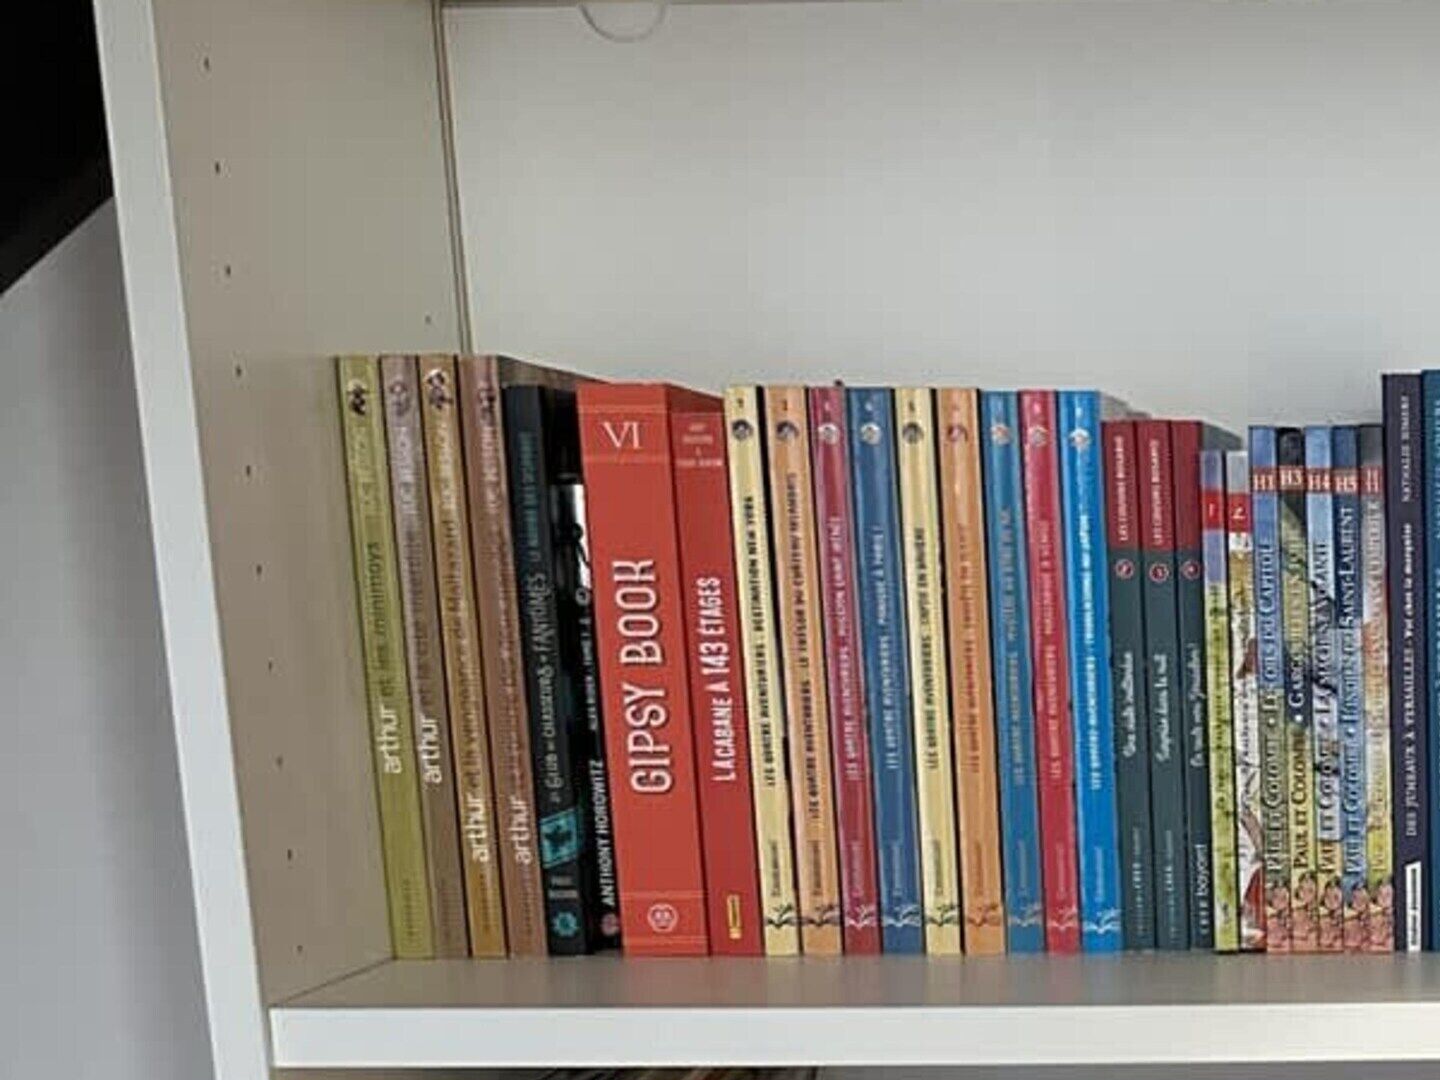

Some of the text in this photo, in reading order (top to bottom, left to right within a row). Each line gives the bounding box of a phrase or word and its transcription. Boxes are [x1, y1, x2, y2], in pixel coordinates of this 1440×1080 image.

[602, 420, 641, 449] VI
[696, 577, 725, 635] ÉTAGES
[611, 559, 674, 793] GIPSY BOOK
[700, 641, 729, 674] 143
[1402, 648, 1416, 724] VERSAILLES
[378, 705, 403, 774] arthur
[417, 712, 443, 783] arthur
[1405, 745, 1419, 807] JUMEAUX
[465, 794, 490, 862] arthur
[509, 796, 531, 864] arthur
[589, 760, 615, 906] ANTHONY HOROWITZ
[1292, 809, 1308, 869] PAUL ET
[1405, 811, 1417, 836] DES
[1195, 844, 1209, 896] bayard
